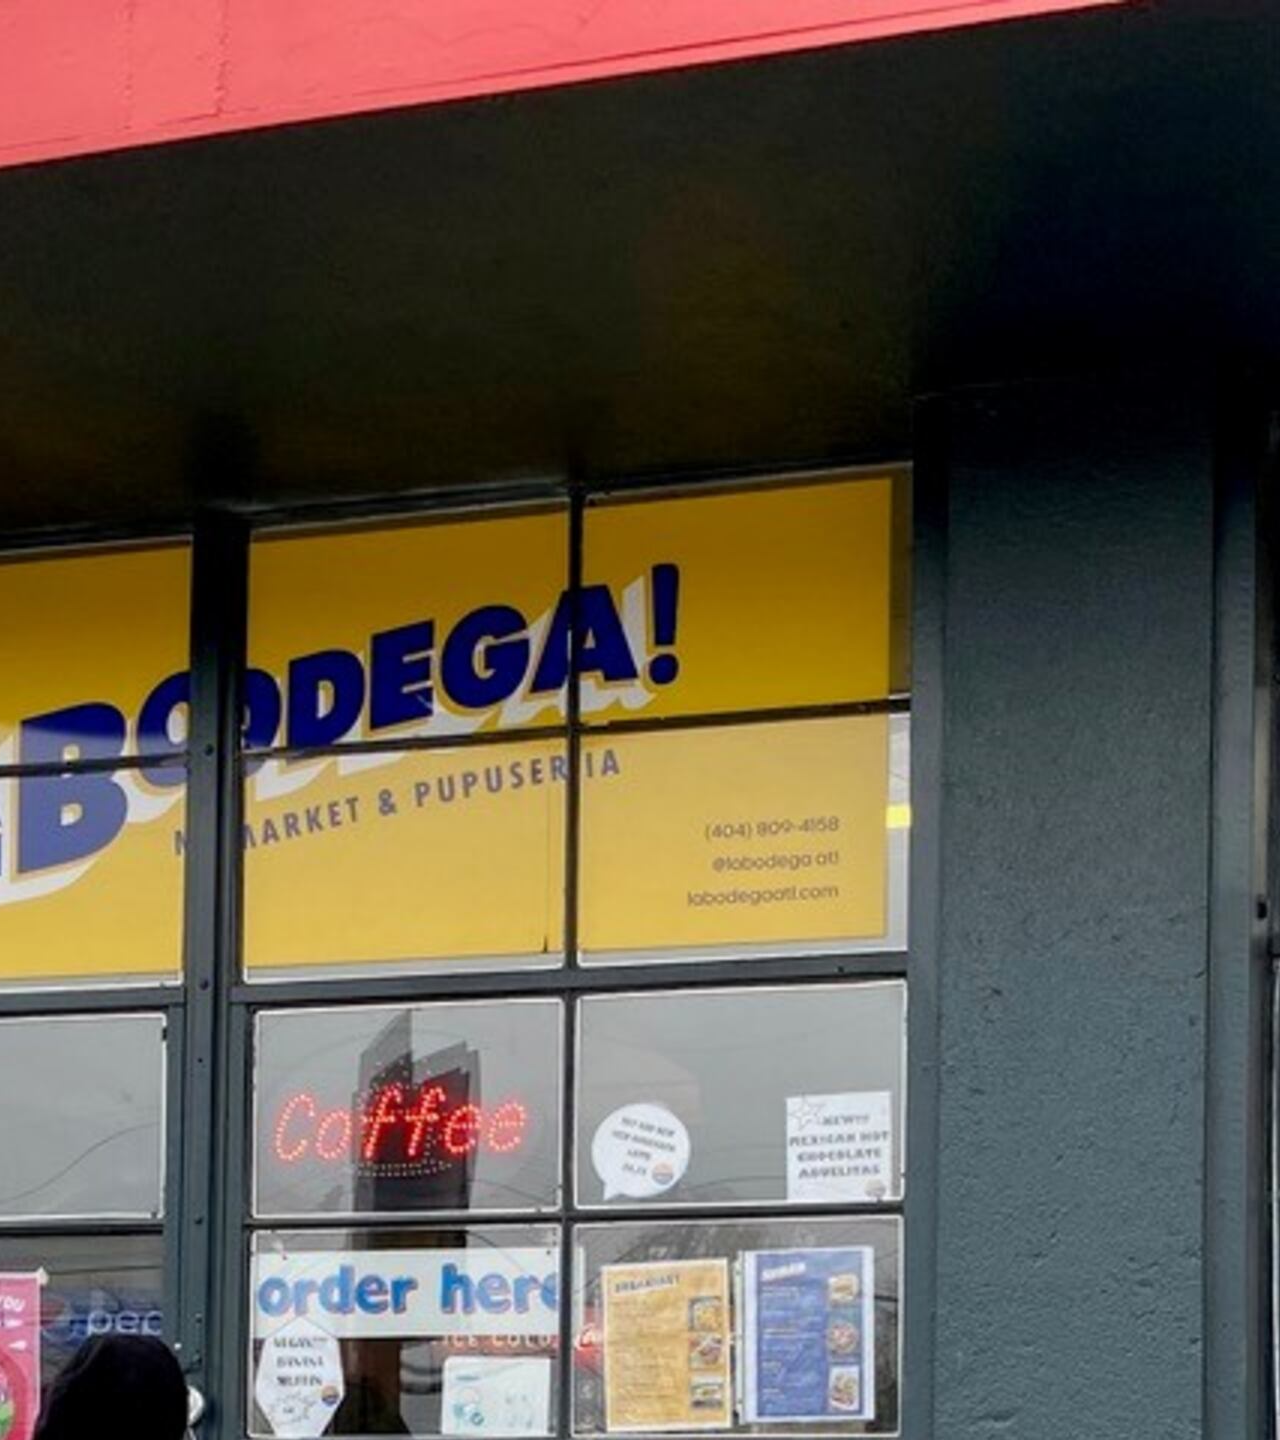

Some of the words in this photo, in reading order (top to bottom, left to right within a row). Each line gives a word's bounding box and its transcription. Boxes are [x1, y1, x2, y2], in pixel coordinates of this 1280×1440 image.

[377, 787, 398, 817] &
[704, 822, 753, 842] (404)
[274, 1081, 526, 1161] Coffee
[257, 1264, 419, 1316] order
